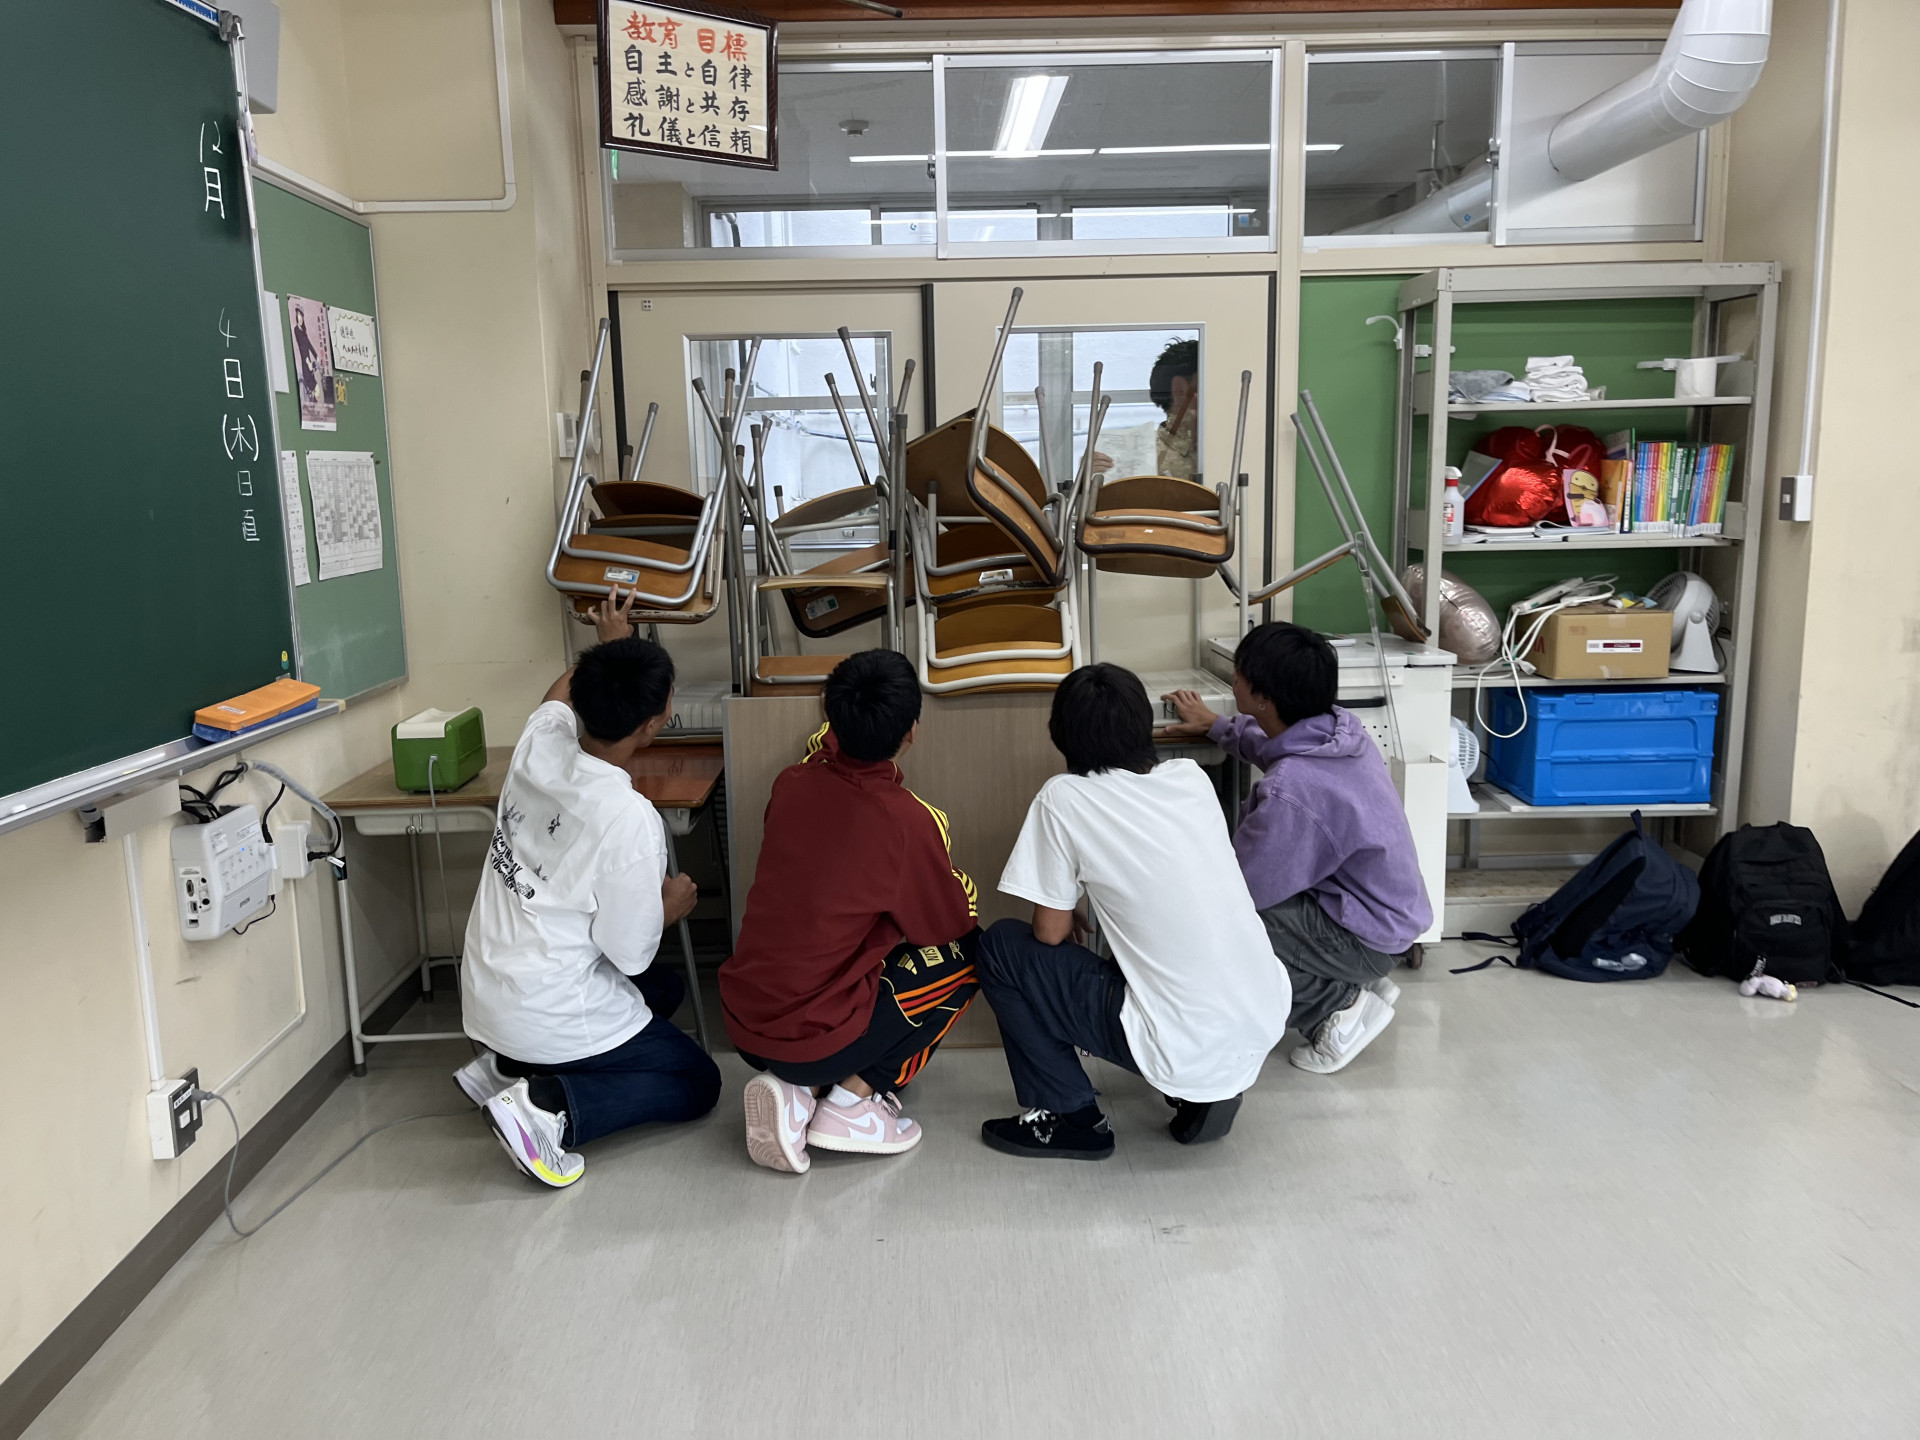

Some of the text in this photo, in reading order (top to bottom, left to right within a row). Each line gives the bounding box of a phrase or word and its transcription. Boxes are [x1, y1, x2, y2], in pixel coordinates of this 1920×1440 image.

[624, 44, 752, 93] 自主と自律
[622, 77, 750, 122] 感謝と共存
[623, 112, 752, 154] 礼儀と信頼
